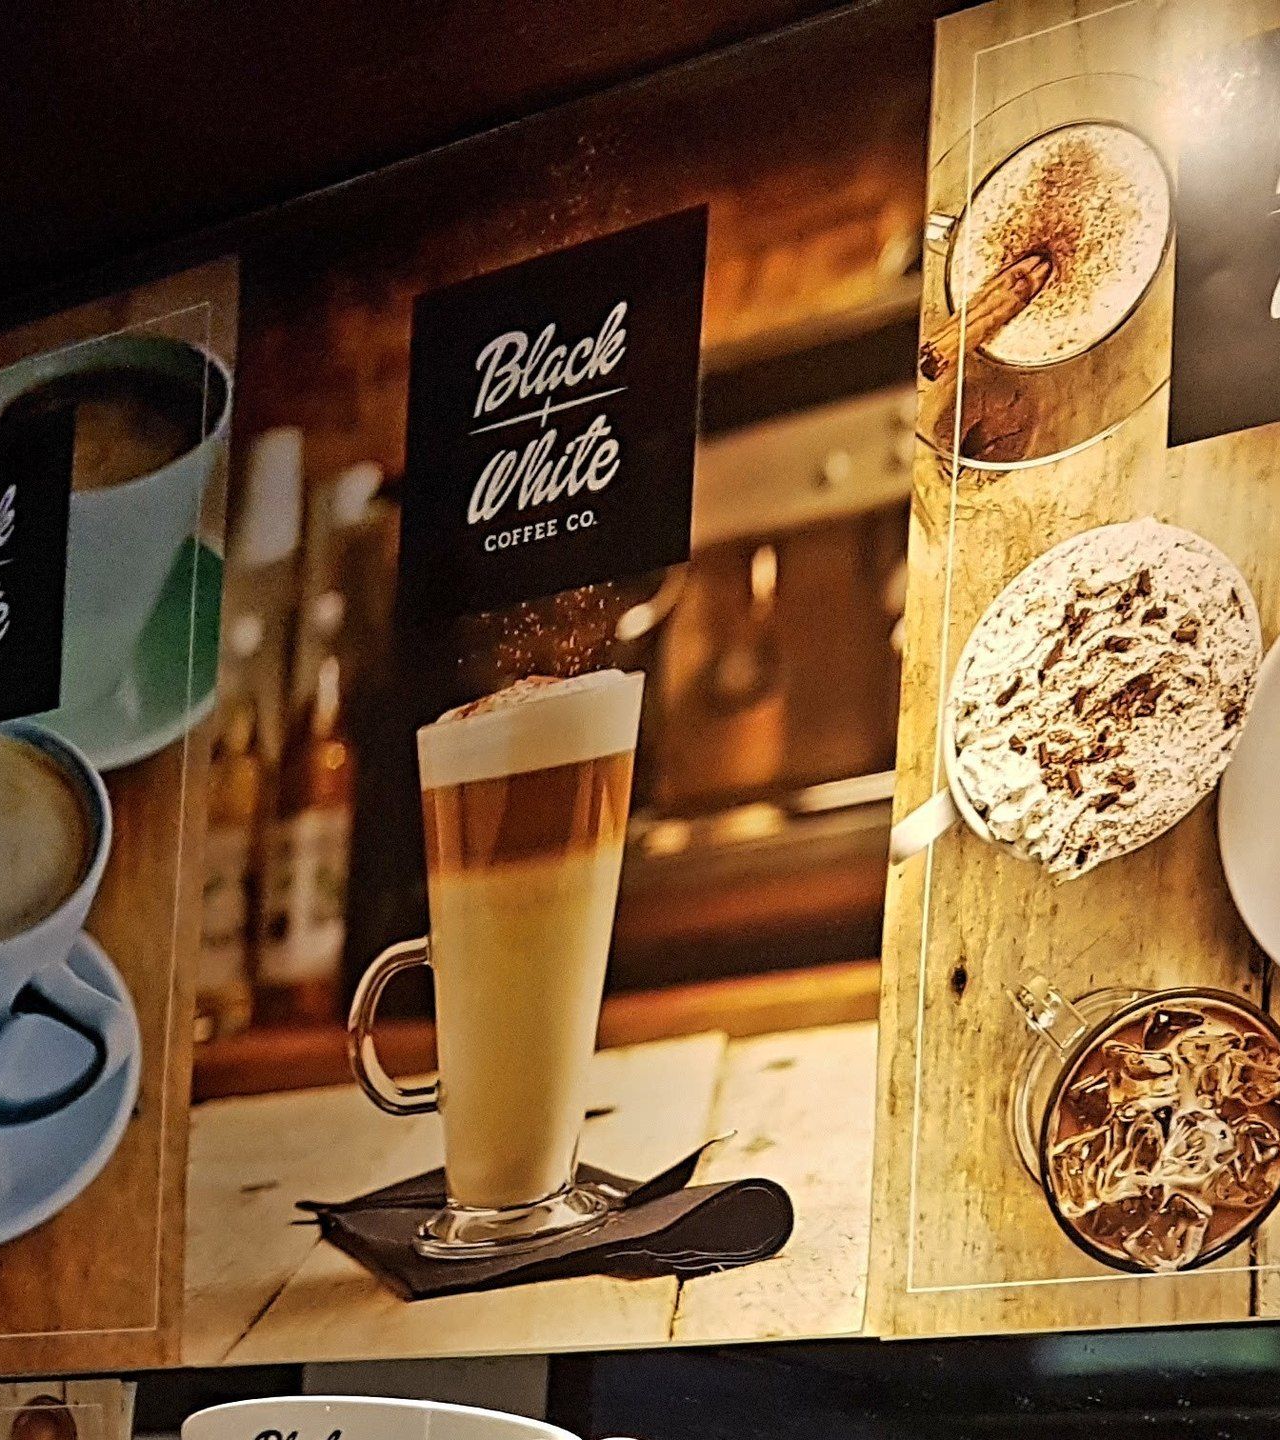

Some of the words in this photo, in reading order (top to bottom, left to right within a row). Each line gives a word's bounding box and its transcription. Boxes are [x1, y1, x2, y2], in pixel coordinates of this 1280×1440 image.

[473, 301, 627, 418] Black
[467, 414, 620, 525] White
[484, 519, 557, 551] COFFEE
[566, 510, 597, 531] CO.
